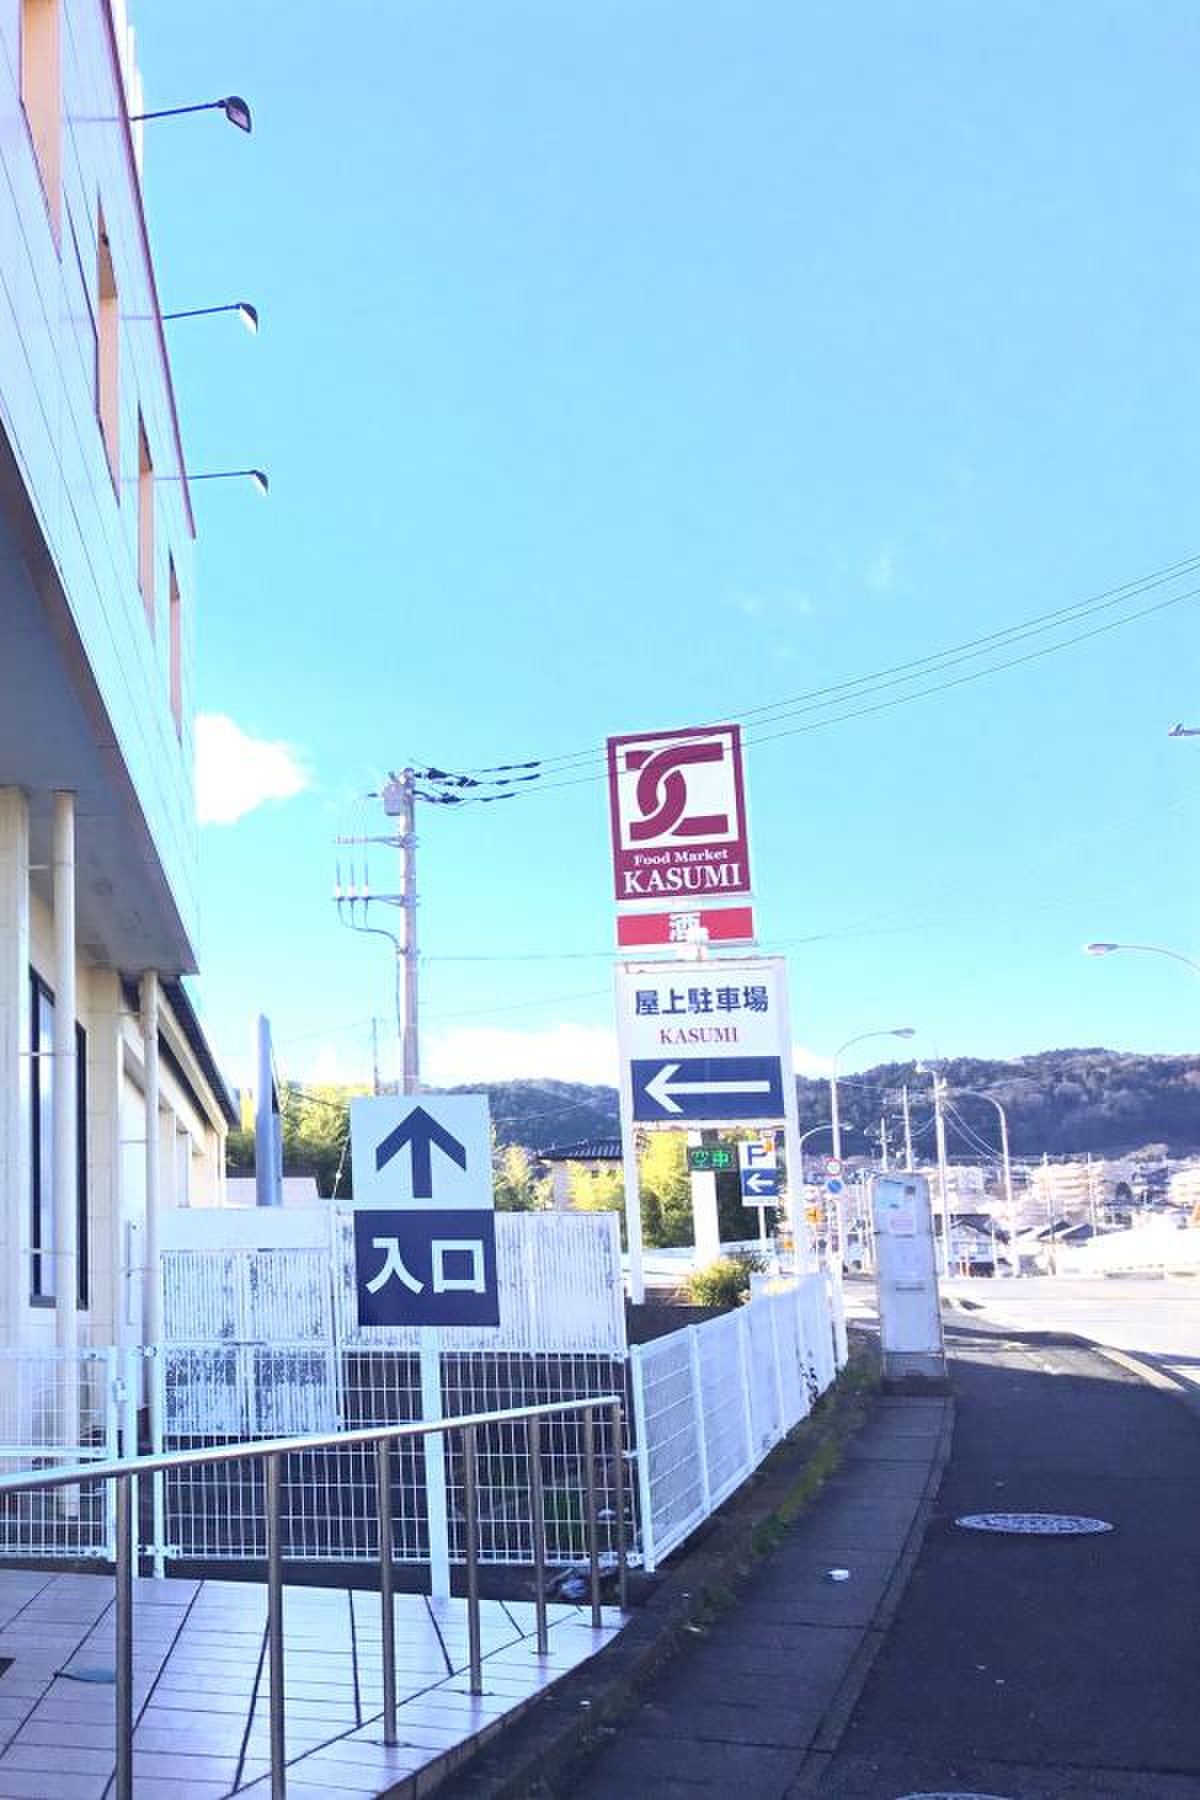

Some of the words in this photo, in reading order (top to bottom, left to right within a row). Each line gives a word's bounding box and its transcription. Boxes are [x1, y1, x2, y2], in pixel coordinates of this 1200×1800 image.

[633, 851, 671, 866] Food
[674, 848, 728, 863] Market
[623, 863, 742, 893] KASUMI
[635, 985, 769, 1016] 屋上駐車場
[659, 1026, 737, 1045] KASUMI
[747, 1144, 771, 1166] P
[365, 1236, 486, 1294] 入口
